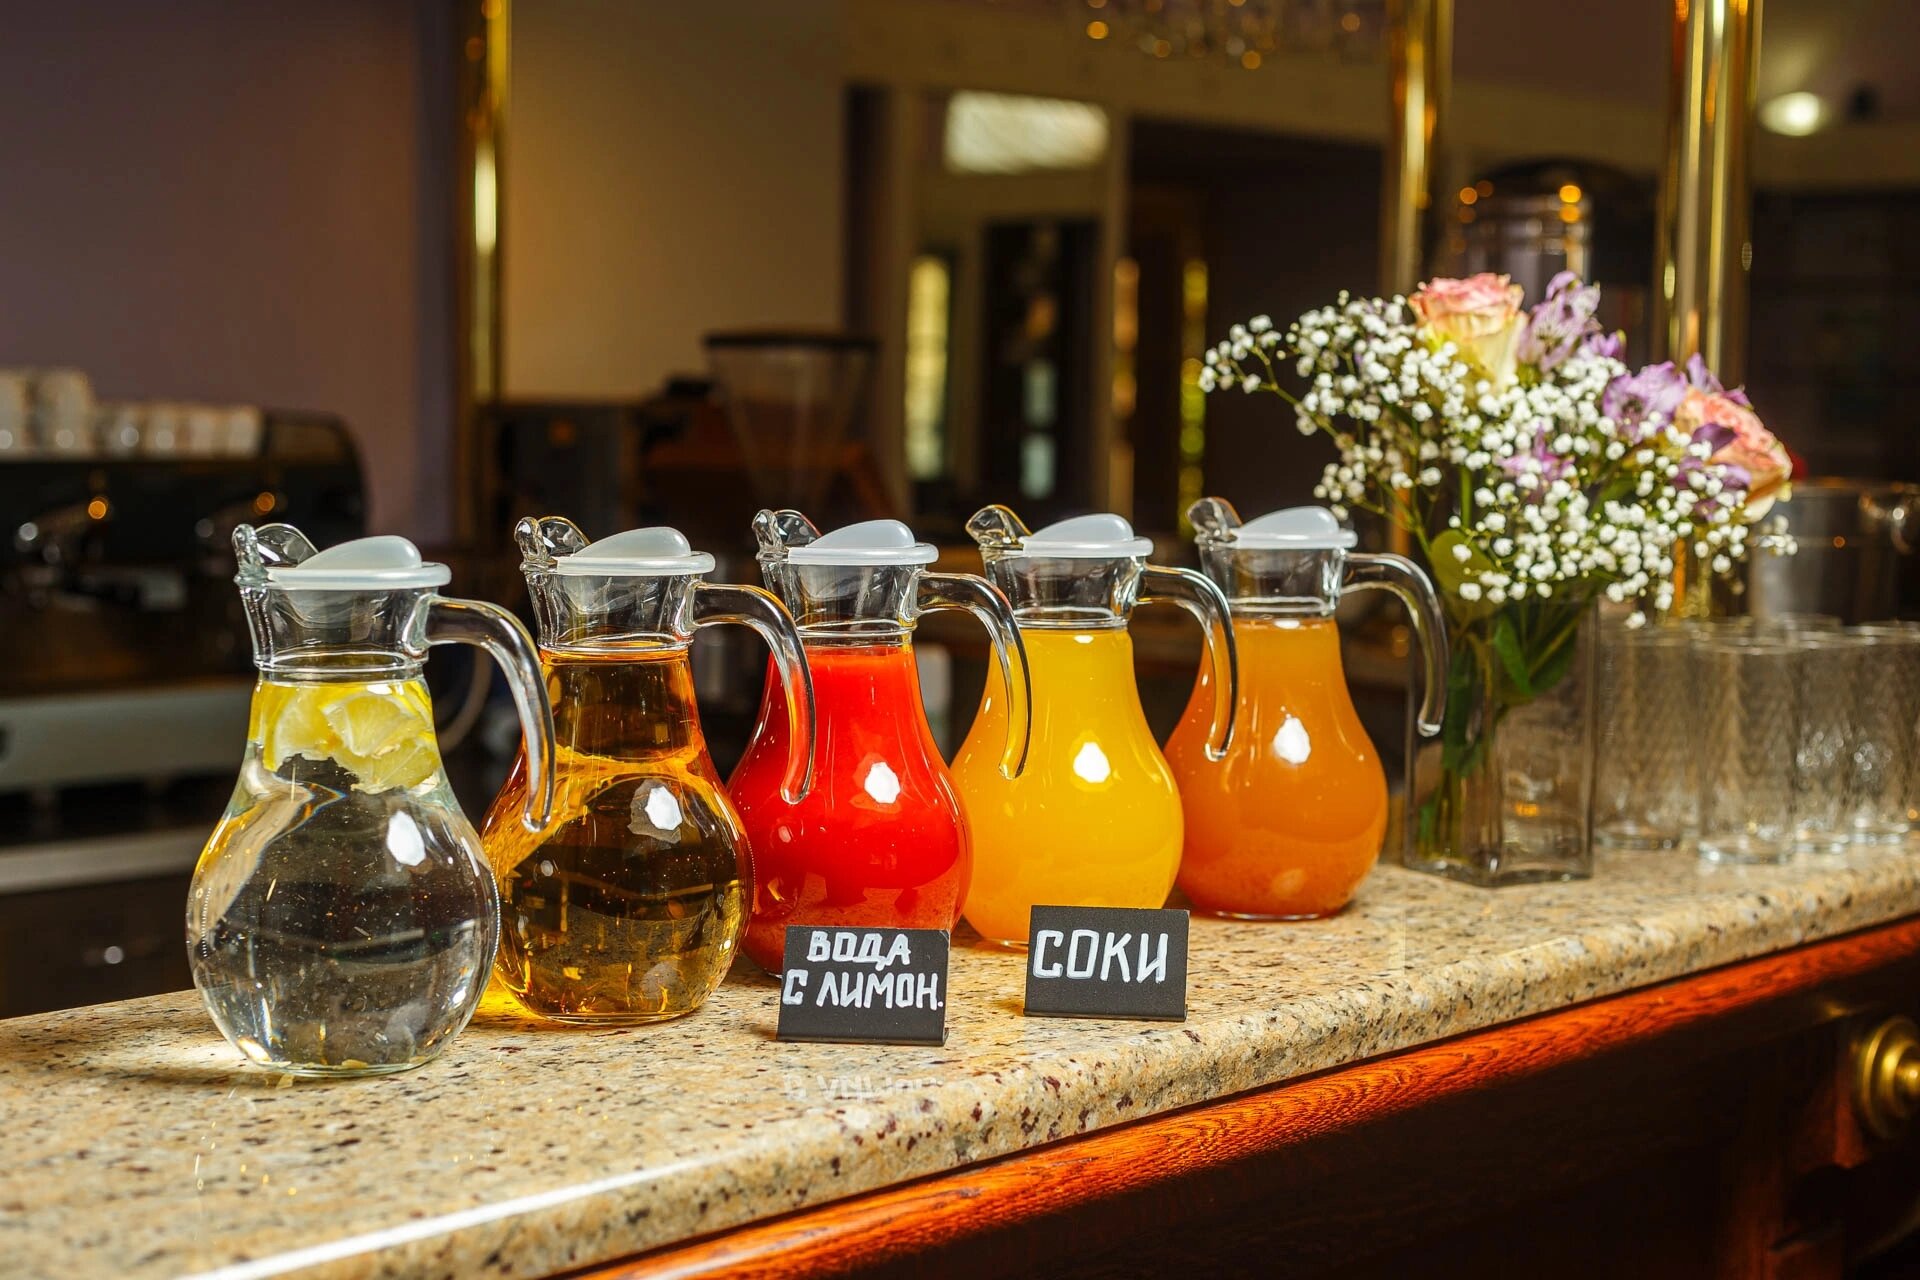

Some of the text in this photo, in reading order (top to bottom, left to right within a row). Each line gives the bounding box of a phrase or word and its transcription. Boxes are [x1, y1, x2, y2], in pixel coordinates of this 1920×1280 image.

[807, 930, 911, 971] ВОДА
[1033, 929, 1168, 983] СОКИ
[782, 969, 944, 1011] С ЛИМОН.
